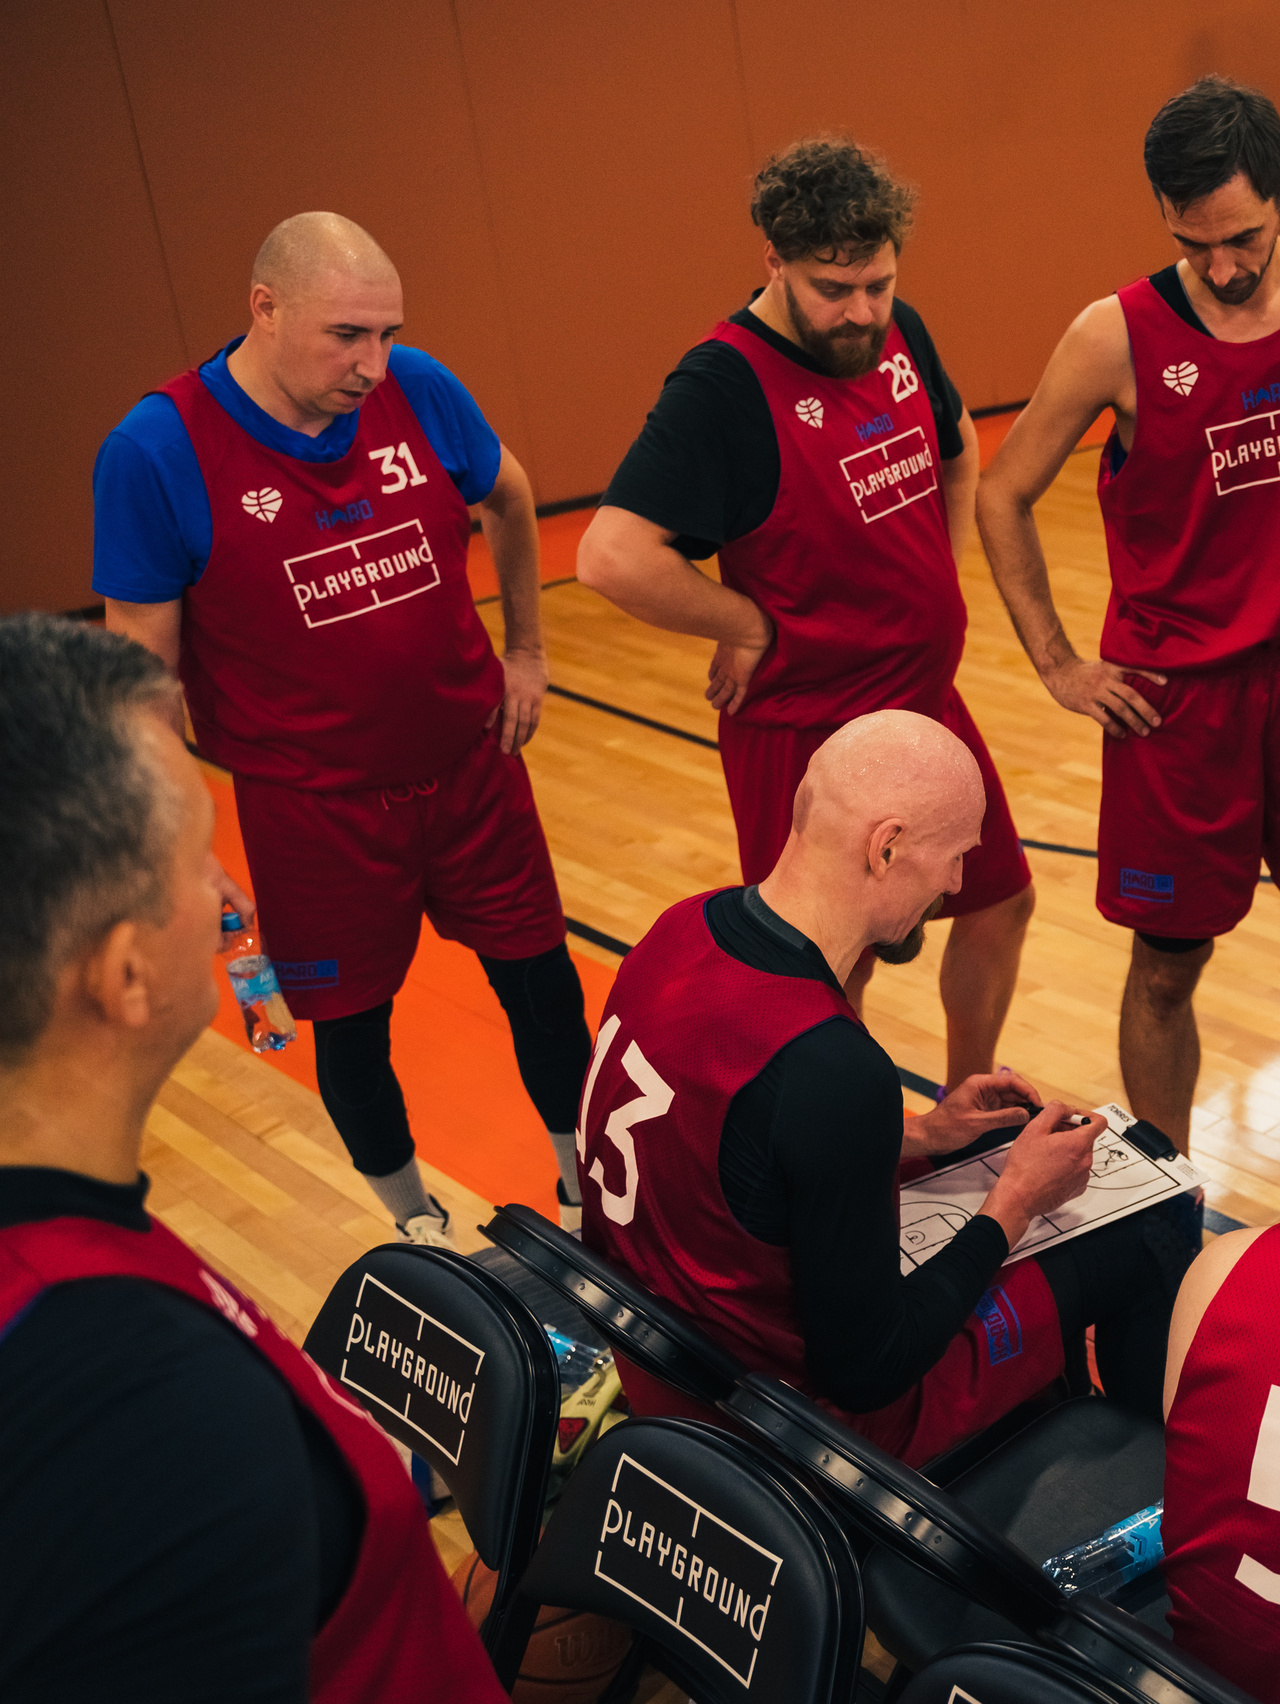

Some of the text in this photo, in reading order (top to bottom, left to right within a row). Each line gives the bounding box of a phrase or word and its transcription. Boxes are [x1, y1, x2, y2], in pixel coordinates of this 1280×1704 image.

[877, 352, 919, 403] 28
[368, 442, 428, 494] 31
[575, 1014, 676, 1226] 13
